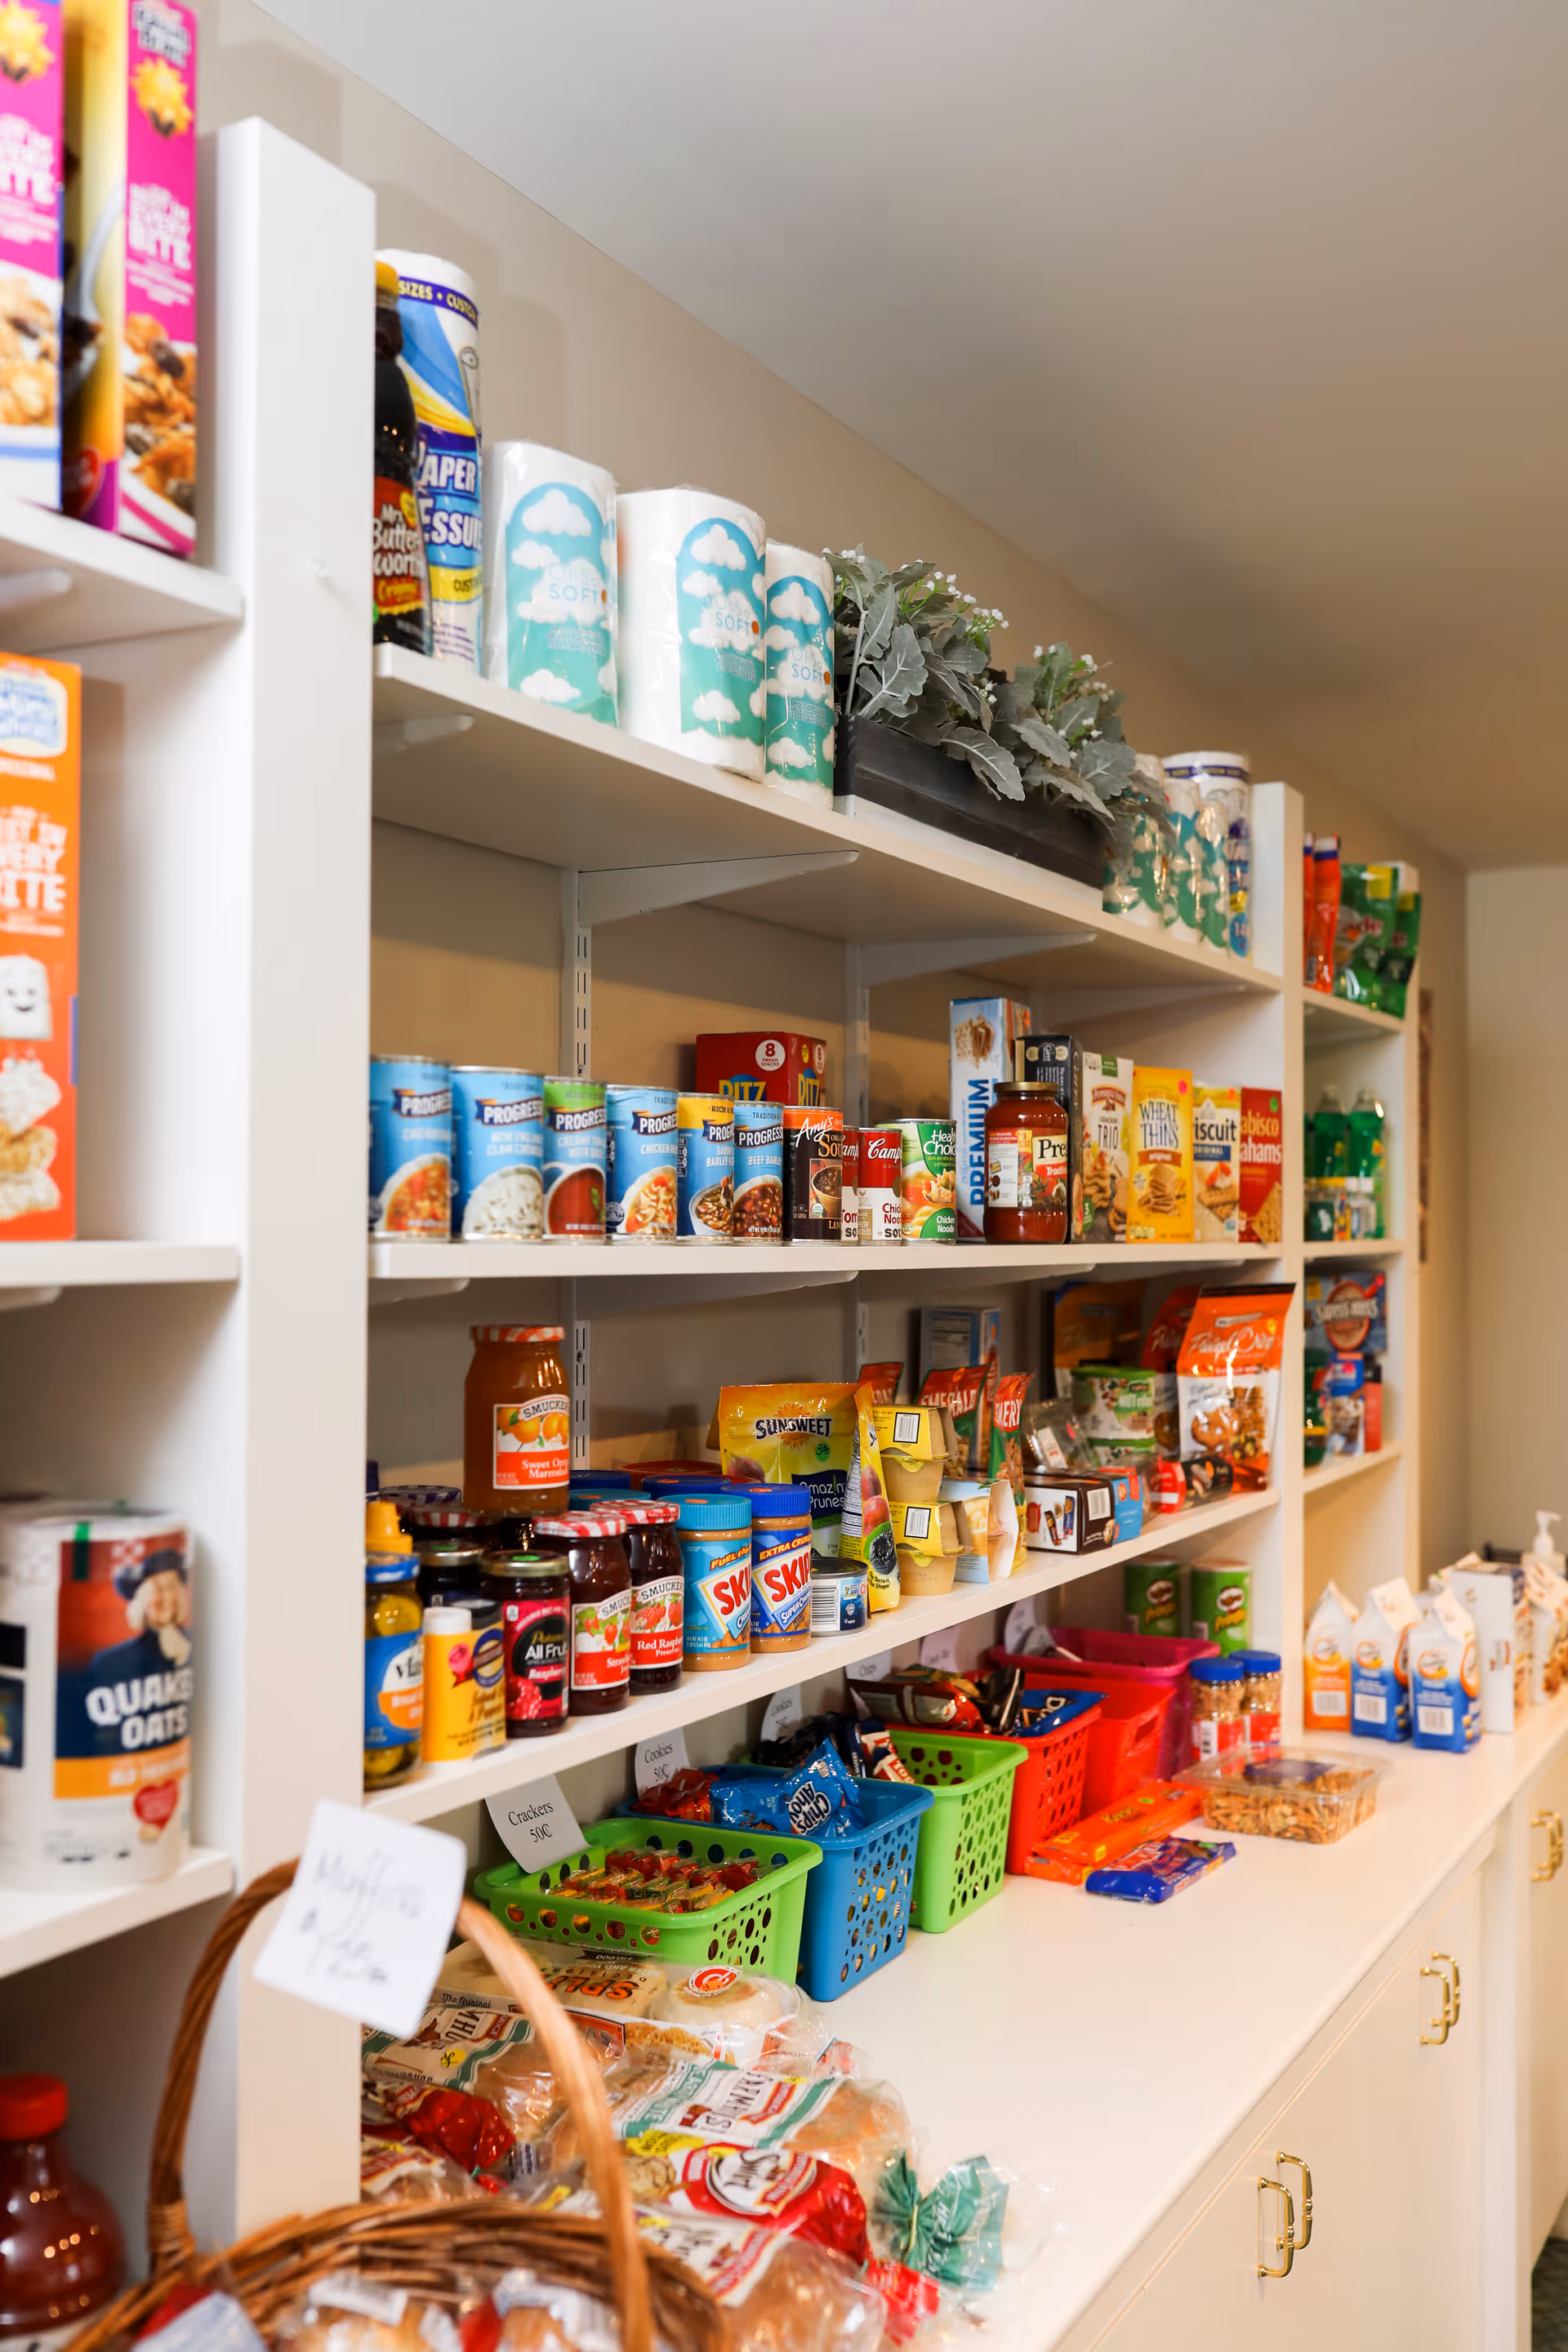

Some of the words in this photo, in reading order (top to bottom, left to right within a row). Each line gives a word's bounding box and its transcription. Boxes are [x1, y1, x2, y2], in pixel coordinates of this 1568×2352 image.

[399, 280, 433, 301] SIZES
[549, 582, 597, 606] SOFT
[715, 612, 750, 635] SOFT
[791, 663, 823, 687] SOFT
[765, 1042, 776, 1058] 8
[1138, 1099, 1179, 1122] WHEAT
[793, 1115, 834, 1148] Amy's
[1098, 1124, 1119, 1150] TRIO
[1140, 1122, 1179, 1150] THINS
[1194, 1116, 1237, 1142] iscuit
[748, 1155, 765, 1165] BEEF
[867, 1138, 902, 1164] Camp
[755, 1418, 832, 1440] SUNSWEET
[522, 1458, 550, 1470] Sweet
[759, 1542, 791, 1561] EXTRA
[764, 1551, 812, 1603] SKIP
[780, 1601, 800, 1624] SUPER
[523, 1644, 544, 1660] All
[637, 1639, 657, 1650] Red
[120, 1706, 189, 1749] OATS
[644, 1742, 673, 1763] Cookies
[788, 1780, 817, 1824] Ahoy
[796, 1791, 831, 1835] Chips
[508, 1802, 554, 1826] Crackers
[443, 1992, 458, 2004] The
[457, 1995, 492, 2009] Original
